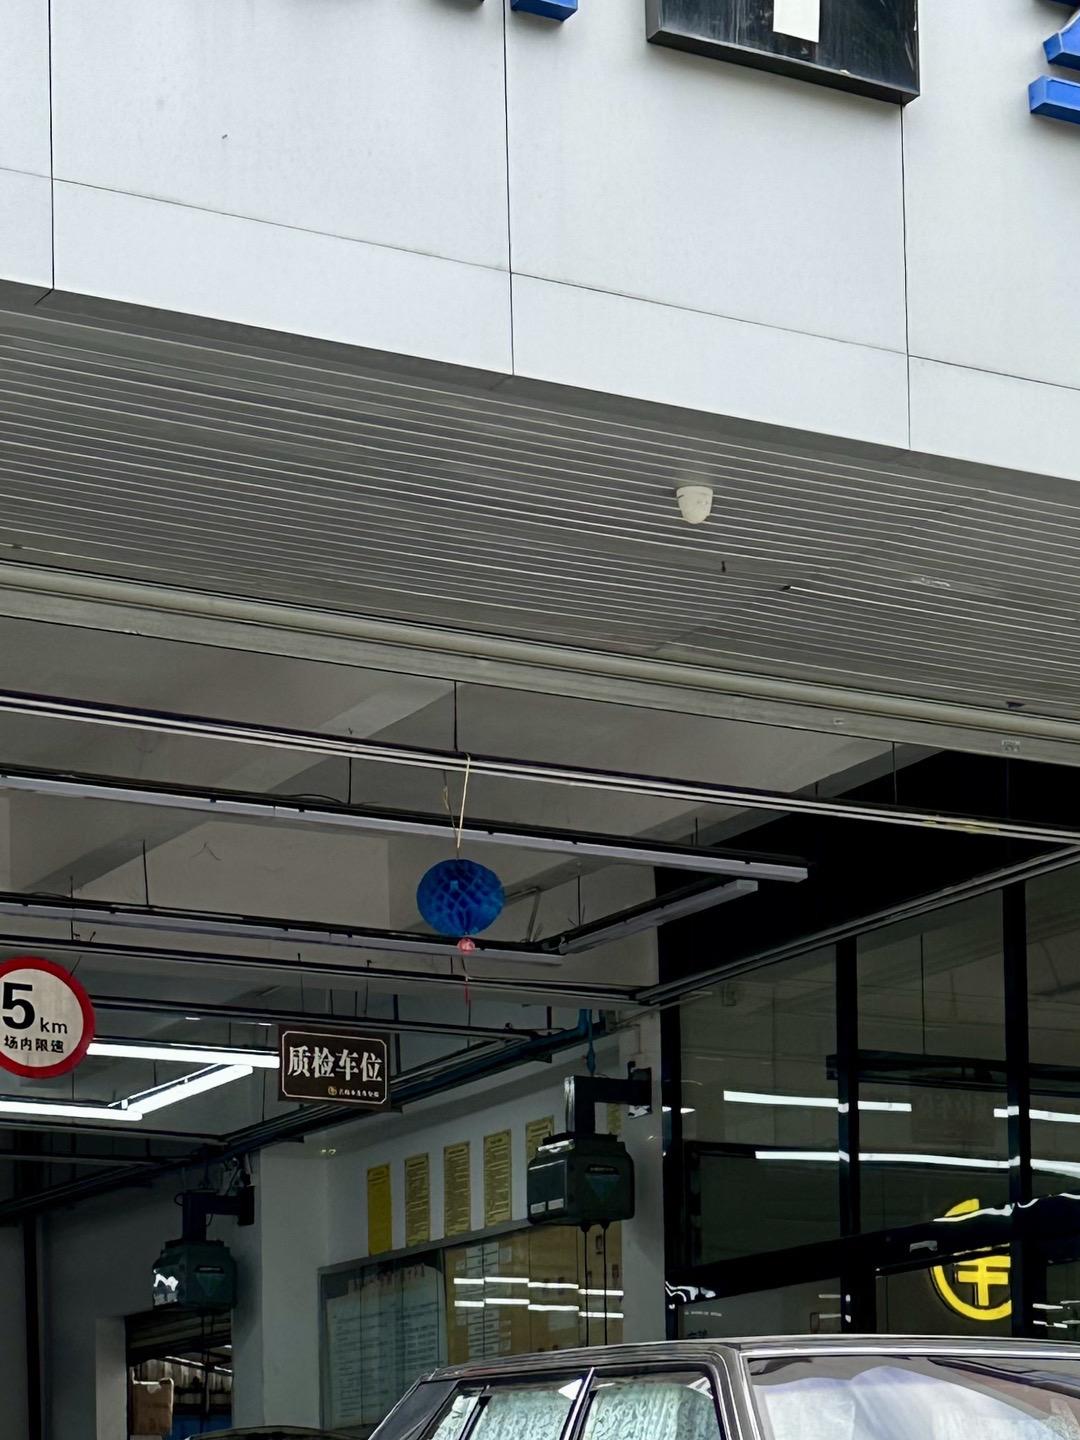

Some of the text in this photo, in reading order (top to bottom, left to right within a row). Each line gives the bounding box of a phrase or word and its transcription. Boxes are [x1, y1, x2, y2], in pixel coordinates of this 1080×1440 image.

[2, 981, 68, 1035] 5 km
[4, 1034, 65, 1054] 场内限速
[287, 1045, 383, 1082] 质检车位
